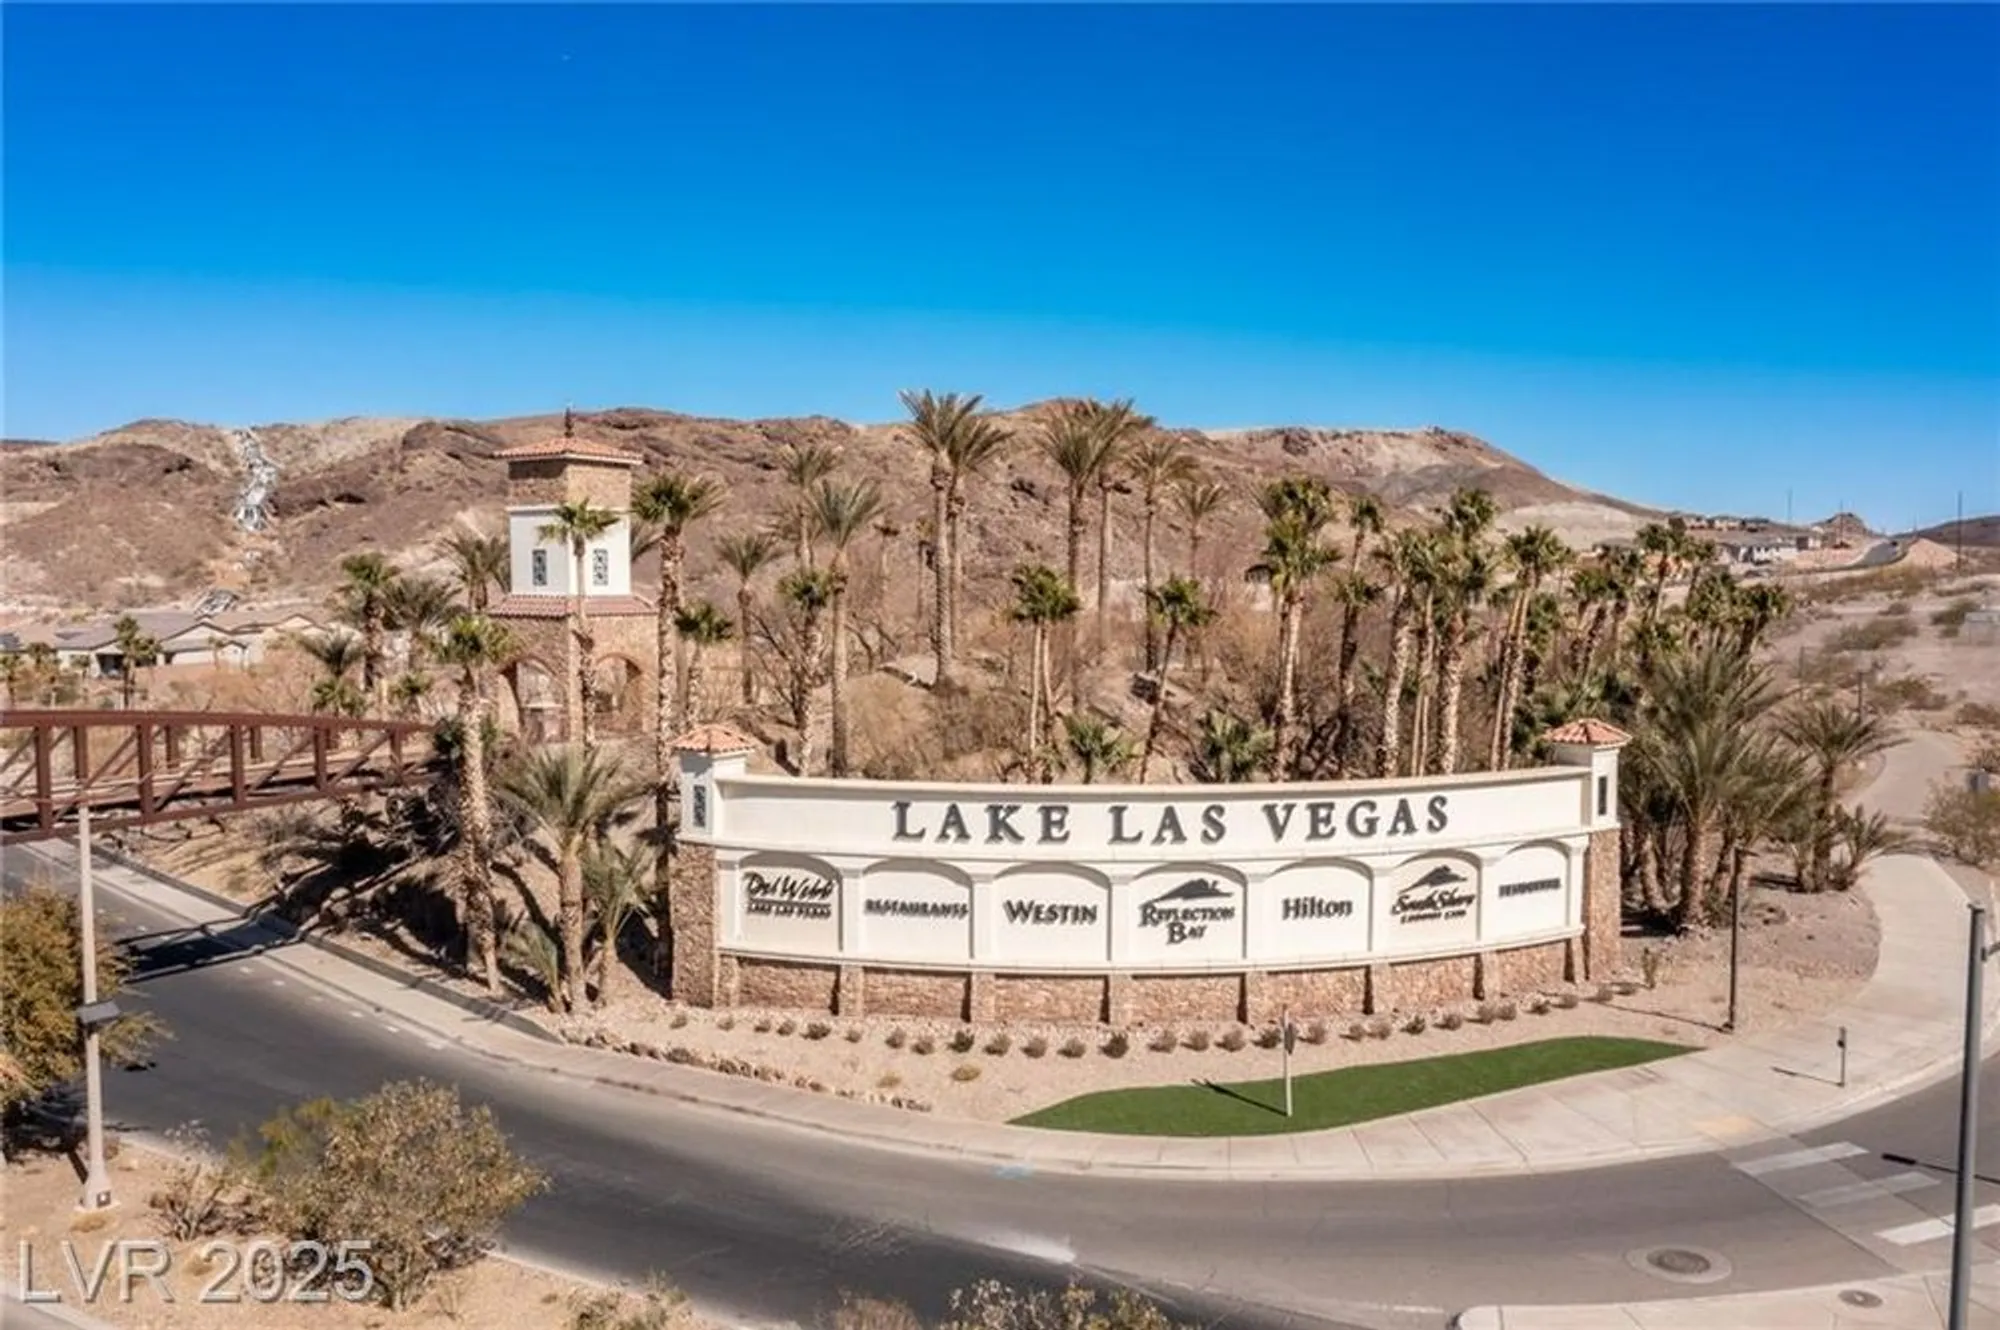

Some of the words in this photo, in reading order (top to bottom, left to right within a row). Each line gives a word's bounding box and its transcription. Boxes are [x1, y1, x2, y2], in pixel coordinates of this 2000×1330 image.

[891, 800, 1071, 845] LAKE
[1107, 804, 1227, 845] LAS
[1261, 795, 1449, 842] VEGAS
[1002, 899, 1098, 925] WESTIN
[1282, 896, 1353, 920] Hilton
[1166, 922, 1207, 945] BAY
